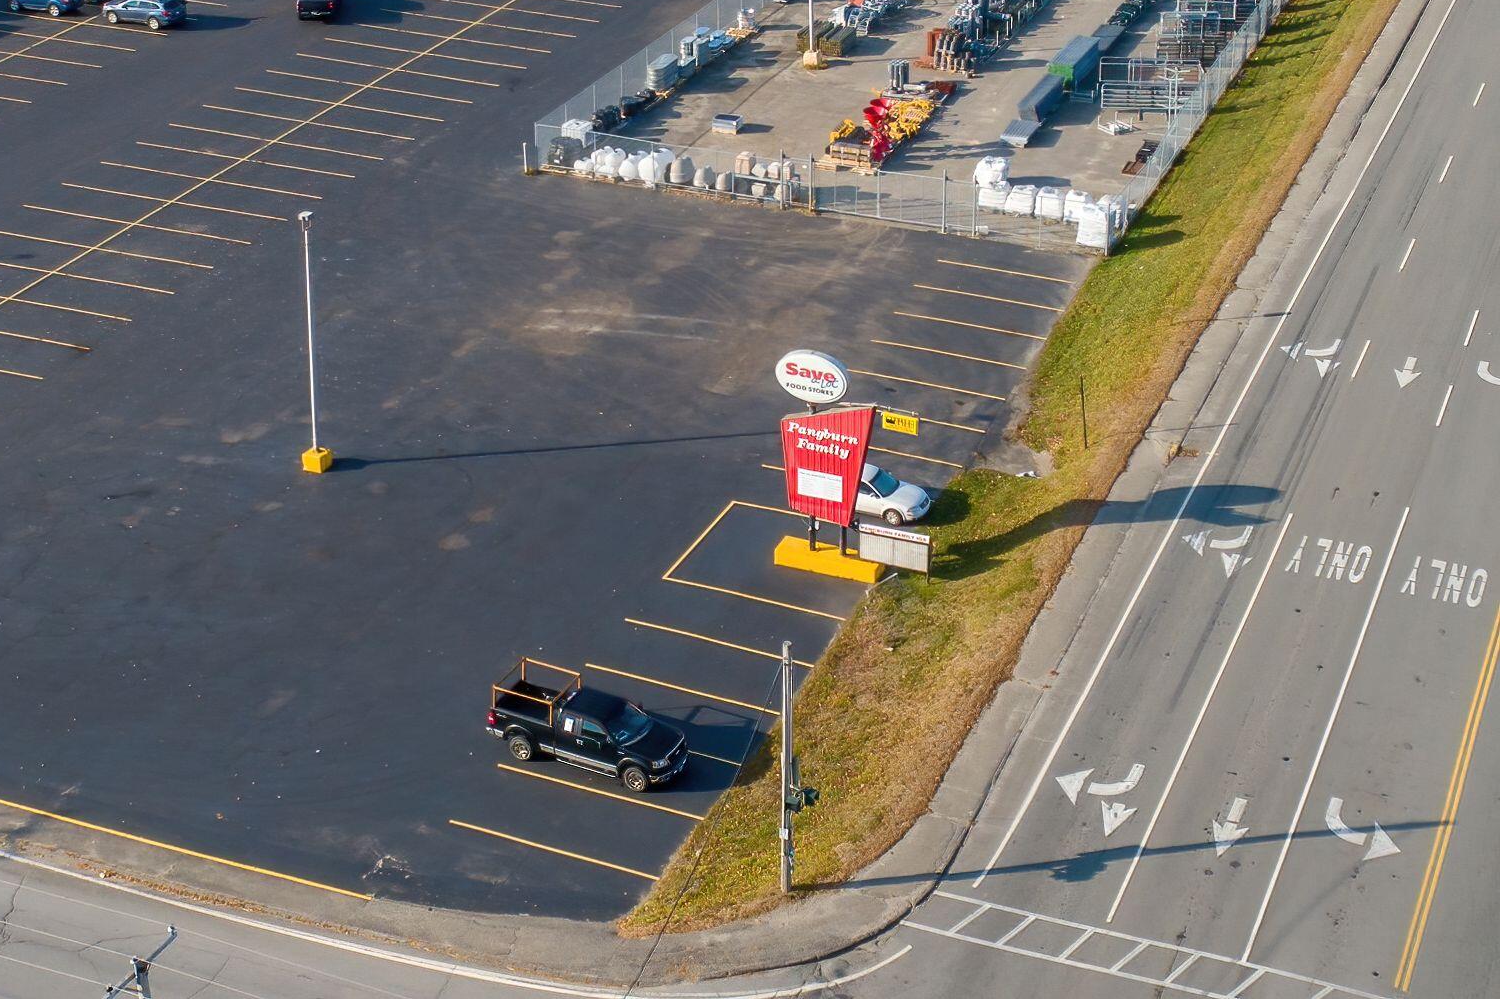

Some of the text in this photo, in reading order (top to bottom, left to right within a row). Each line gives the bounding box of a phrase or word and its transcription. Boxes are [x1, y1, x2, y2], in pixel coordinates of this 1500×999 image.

[785, 362, 836, 383] Save
[785, 382, 834, 396] FOOD STORES
[786, 421, 859, 445] Pangburn
[796, 437, 850, 460] Family
[1284, 535, 1373, 584] ONLY
[1400, 555, 1488, 608] ONLY
